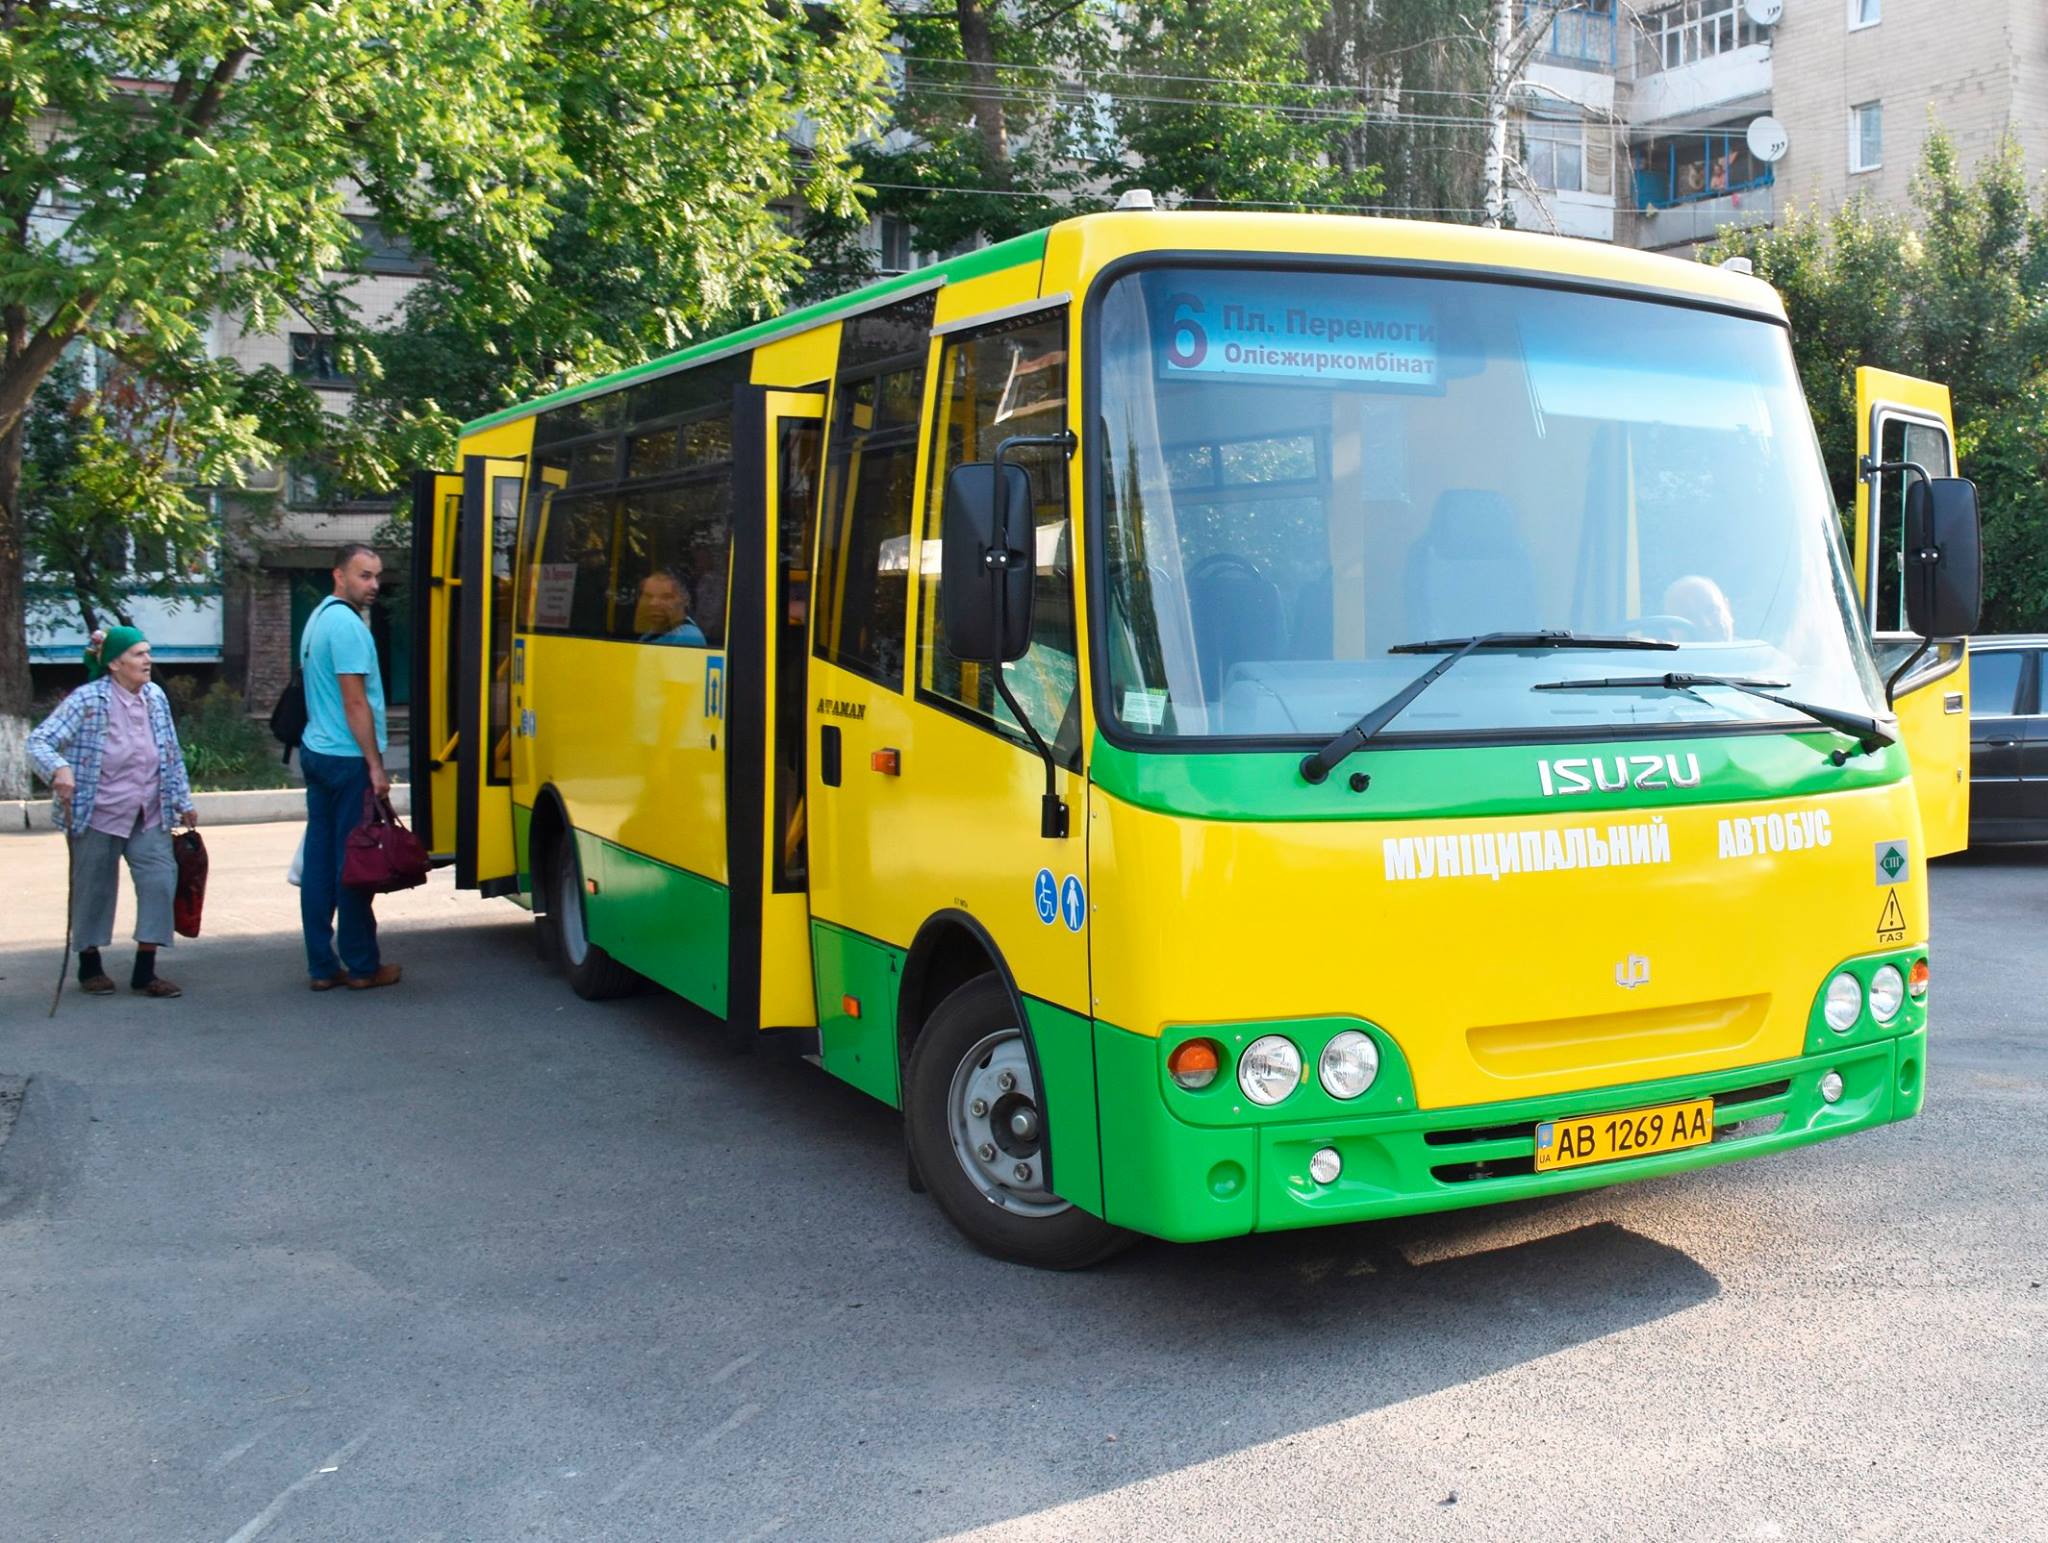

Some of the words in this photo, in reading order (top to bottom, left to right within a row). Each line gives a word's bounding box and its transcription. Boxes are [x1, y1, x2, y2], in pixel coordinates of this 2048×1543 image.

[1167, 293, 1208, 368] 6
[1223, 304, 1275, 333] Пл.
[1286, 308, 1435, 343] Перемоги
[1225, 343, 1434, 375] Олієжиркомбінат
[1537, 753, 1700, 797] ISUZU
[1383, 816, 1671, 881] МУНІЦИПАЛЬНИЙ
[1718, 809, 1832, 859] АВТОБУС
[1879, 932, 1903, 943] ГАЗ
[1556, 1125, 1596, 1161] AB
[1605, 1114, 1664, 1152] 1269
[1671, 1107, 1706, 1142] AA
[1539, 1154, 1551, 1164] UA
